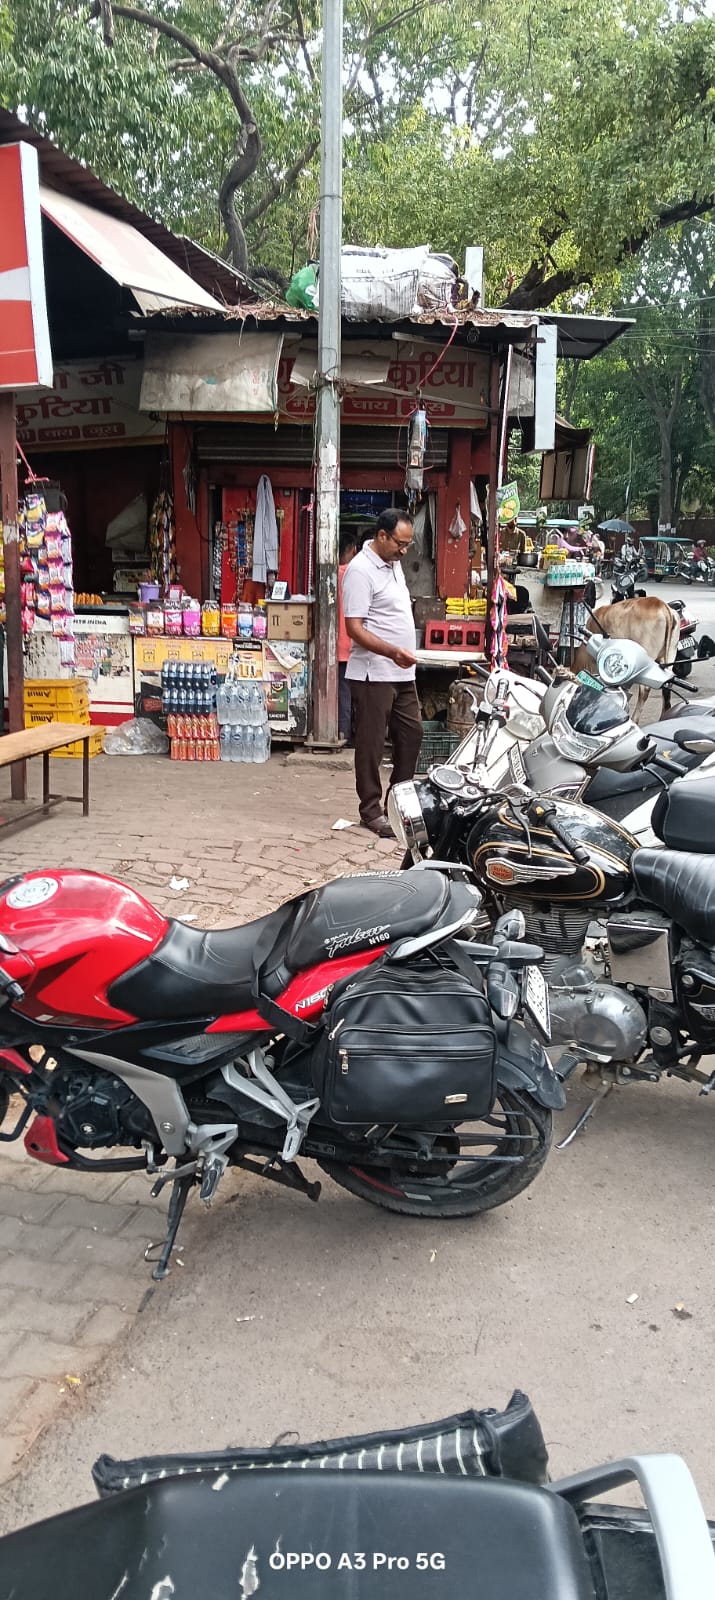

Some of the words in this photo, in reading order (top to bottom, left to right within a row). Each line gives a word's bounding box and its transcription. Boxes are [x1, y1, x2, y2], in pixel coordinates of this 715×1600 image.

[78, 360, 126, 386] जी
[388, 351, 476, 391] कुटिया
[16, 395, 113, 427] कुटिया
[352, 400, 390, 411] चाय
[368, 932, 391, 945] N160
